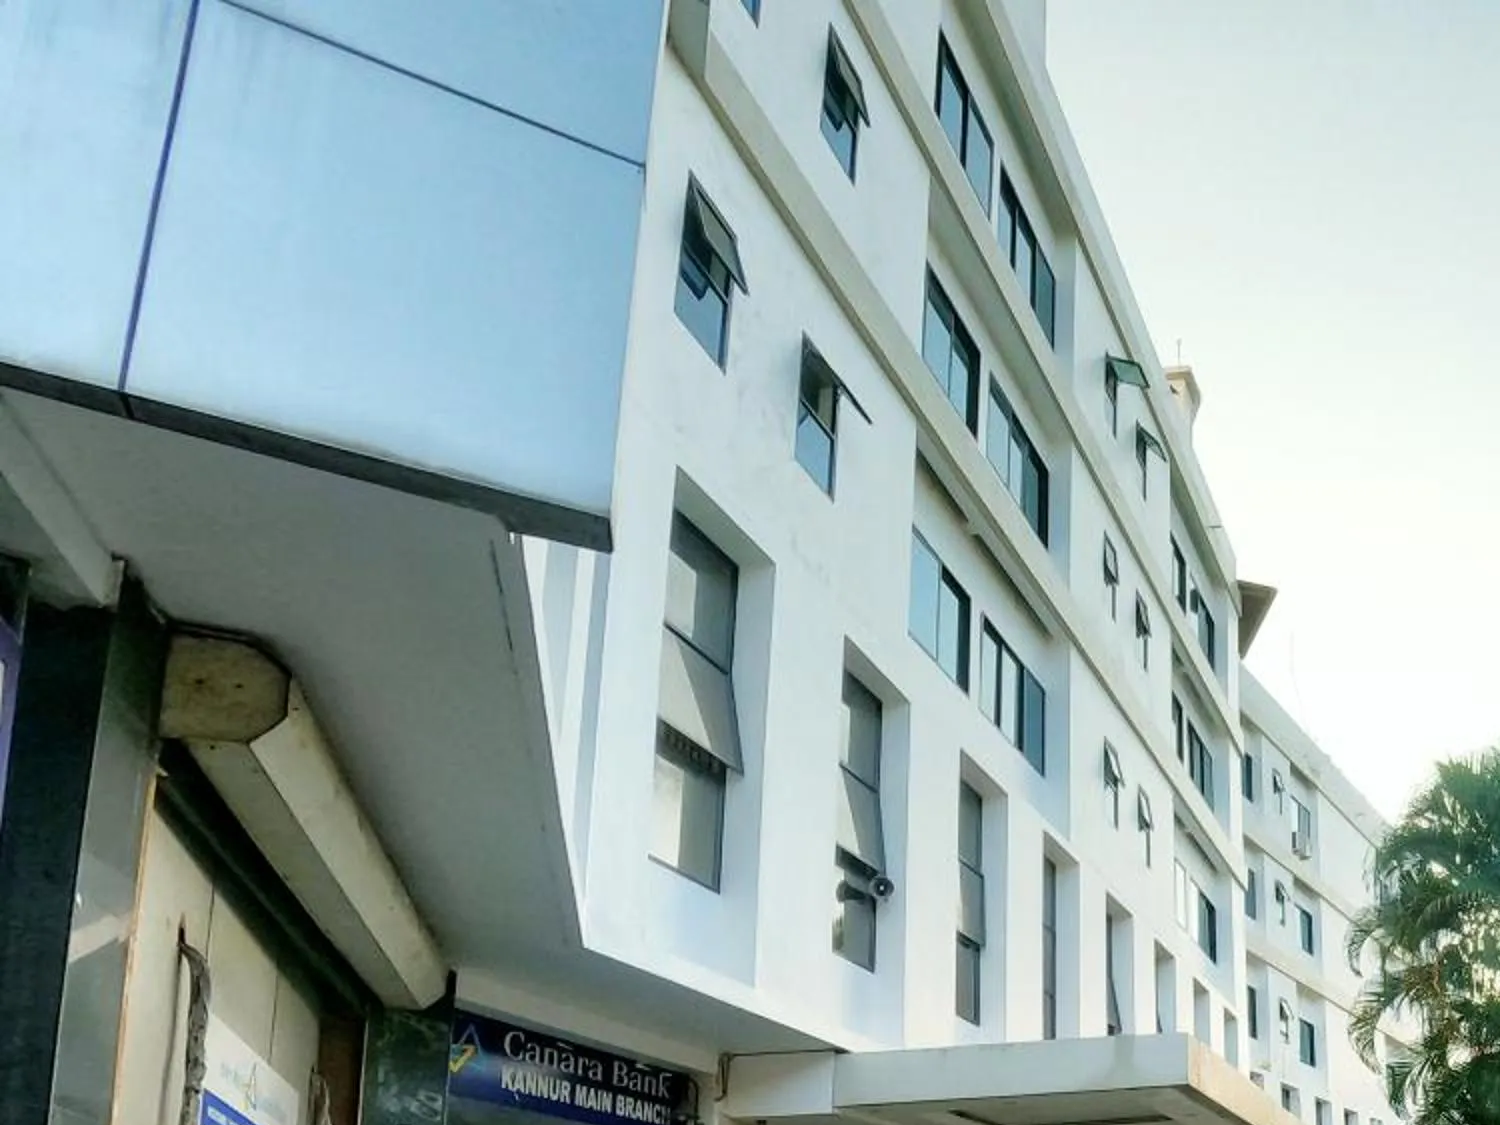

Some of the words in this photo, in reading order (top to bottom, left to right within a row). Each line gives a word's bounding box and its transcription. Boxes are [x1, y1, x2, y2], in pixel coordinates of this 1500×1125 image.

[501, 1064, 571, 1104] KANNUR
[574, 1084, 612, 1114] MAIN
[612, 1058, 673, 1100] Bank
